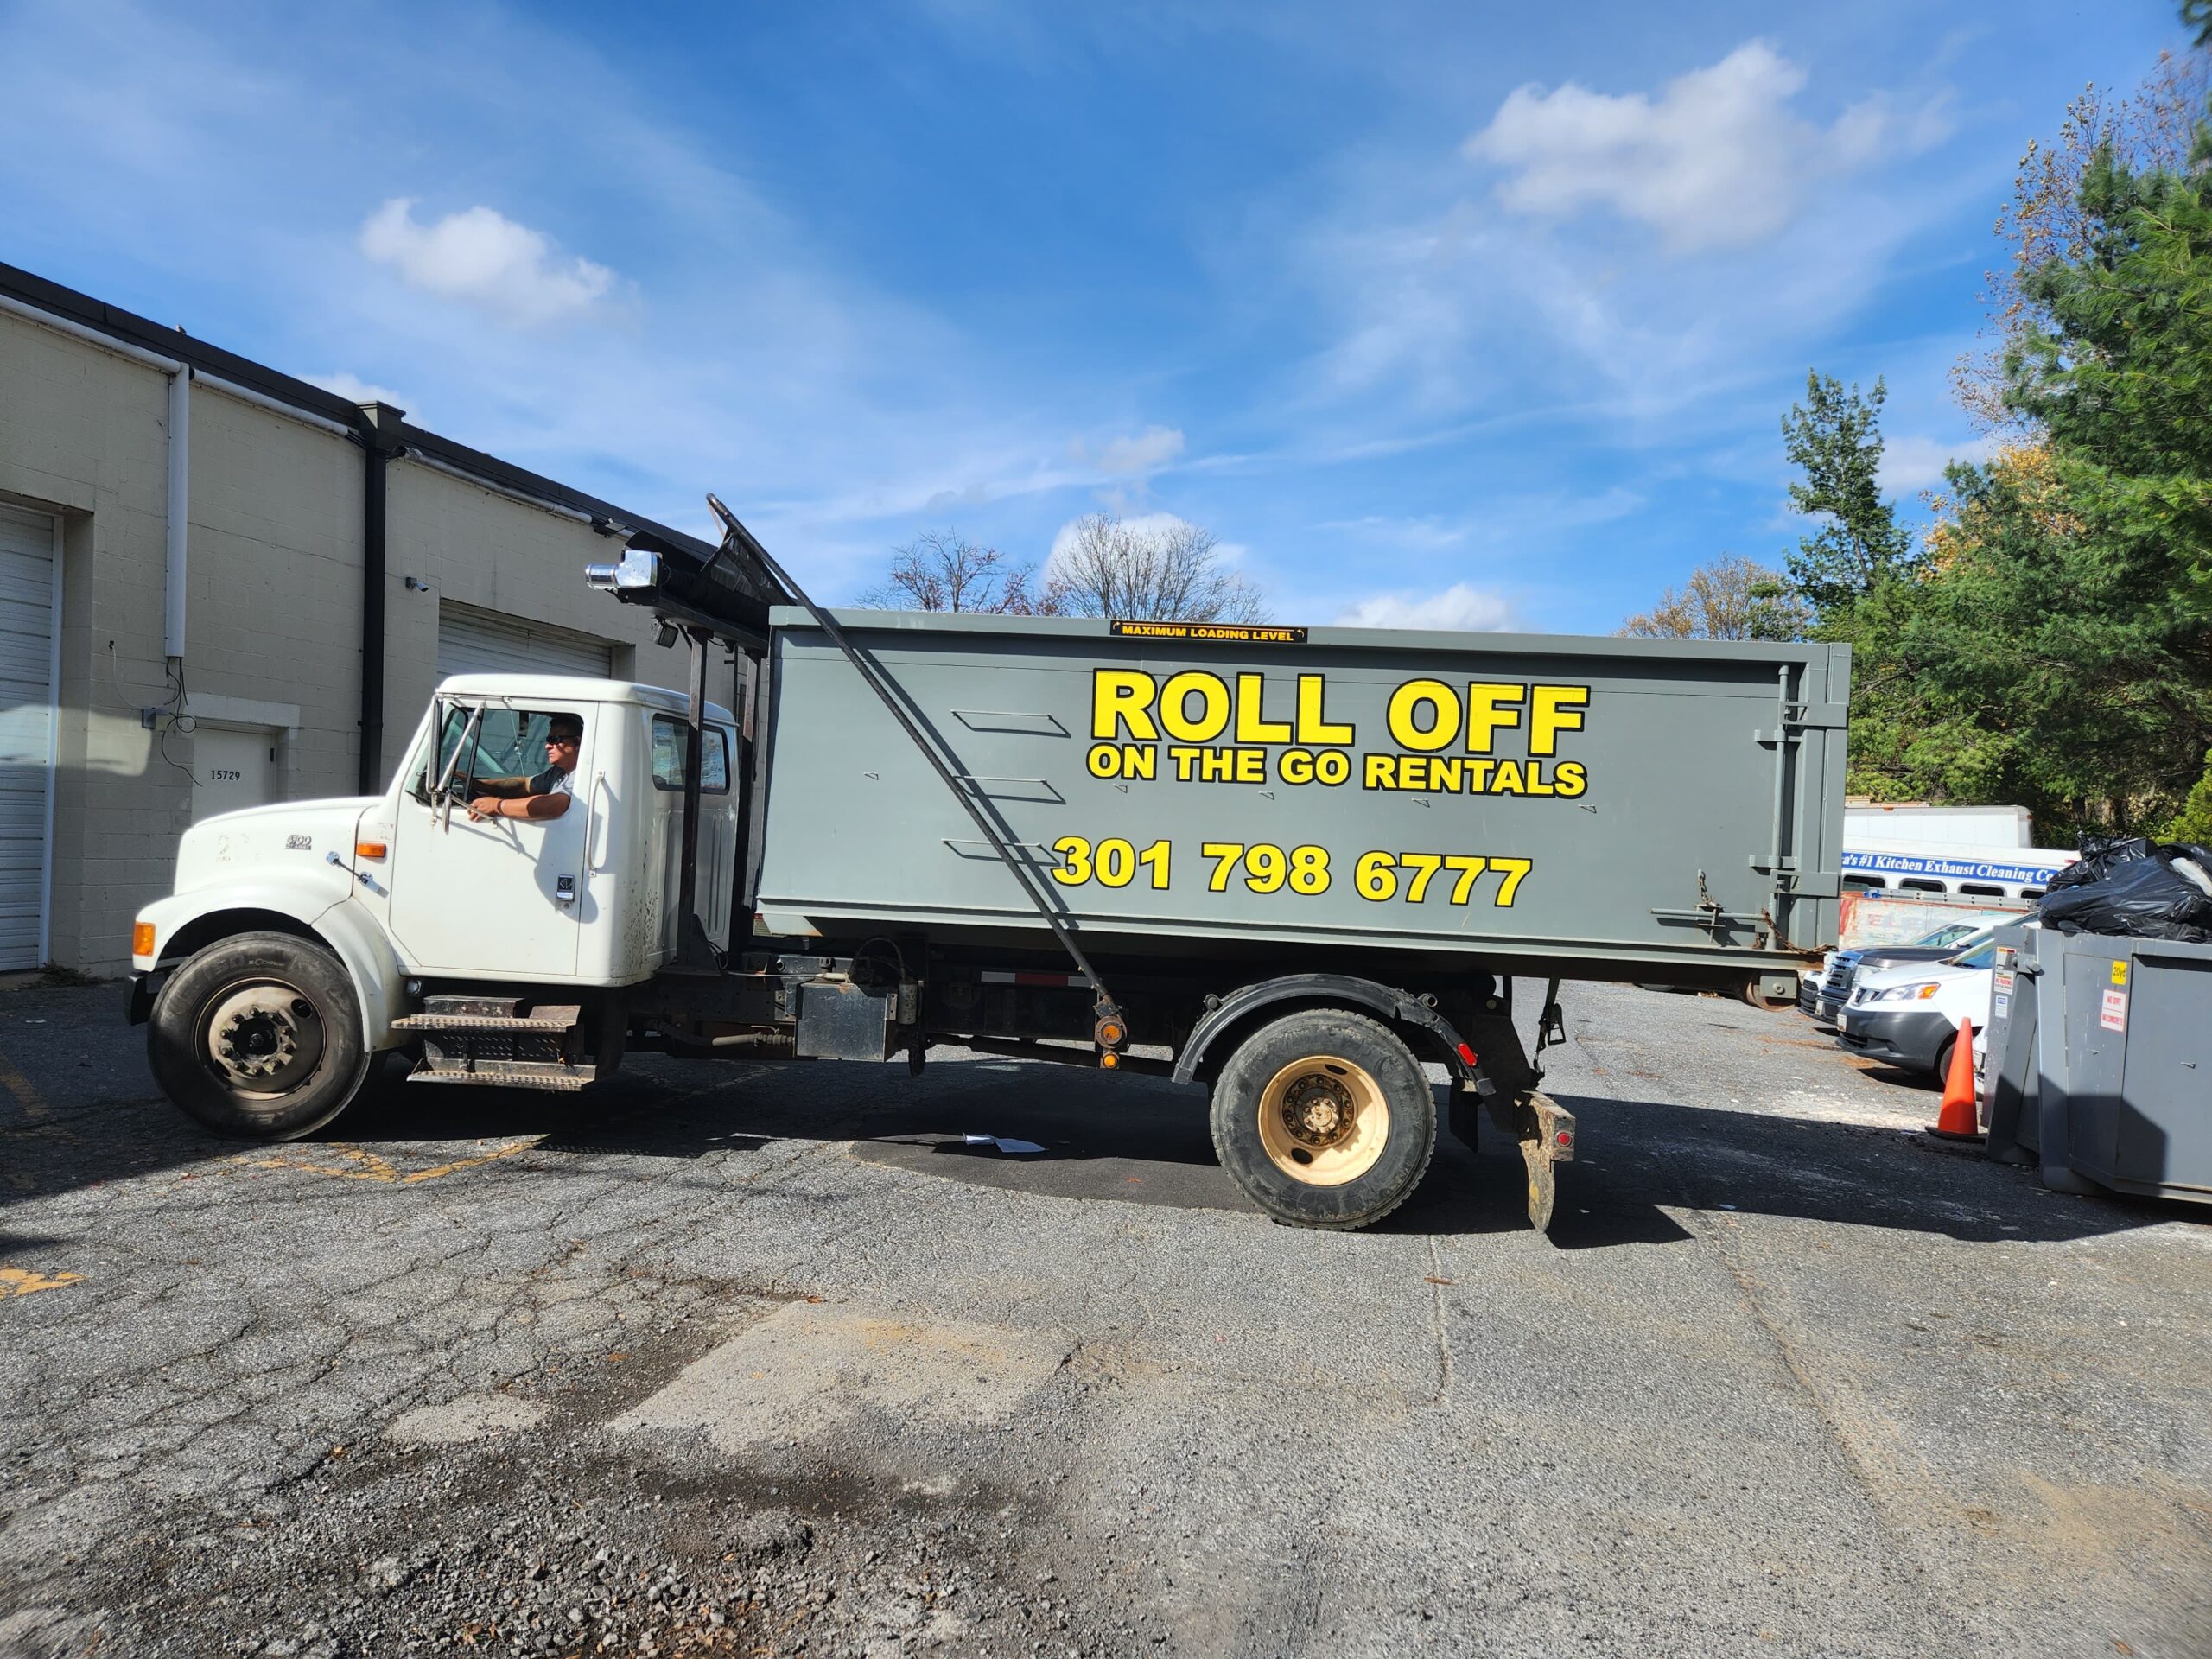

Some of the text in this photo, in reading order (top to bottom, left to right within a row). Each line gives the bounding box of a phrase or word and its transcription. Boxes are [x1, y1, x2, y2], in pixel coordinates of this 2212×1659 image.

[1122, 626, 1294, 641] MAXIMUM LOADING LEVEL
[1092, 669, 1590, 757] ROLL OFF
[212, 770, 240, 781] 15729
[1087, 743, 1587, 798] ON THE GO RENTALS
[1052, 835, 1533, 908] 301 798 6777
[1841, 855, 1858, 866] a's
[1859, 855, 1872, 867] #1
[1874, 855, 1922, 871] Kitchen
[1923, 860, 1974, 875] Exhaust
[1976, 864, 2034, 883] Cleaning
